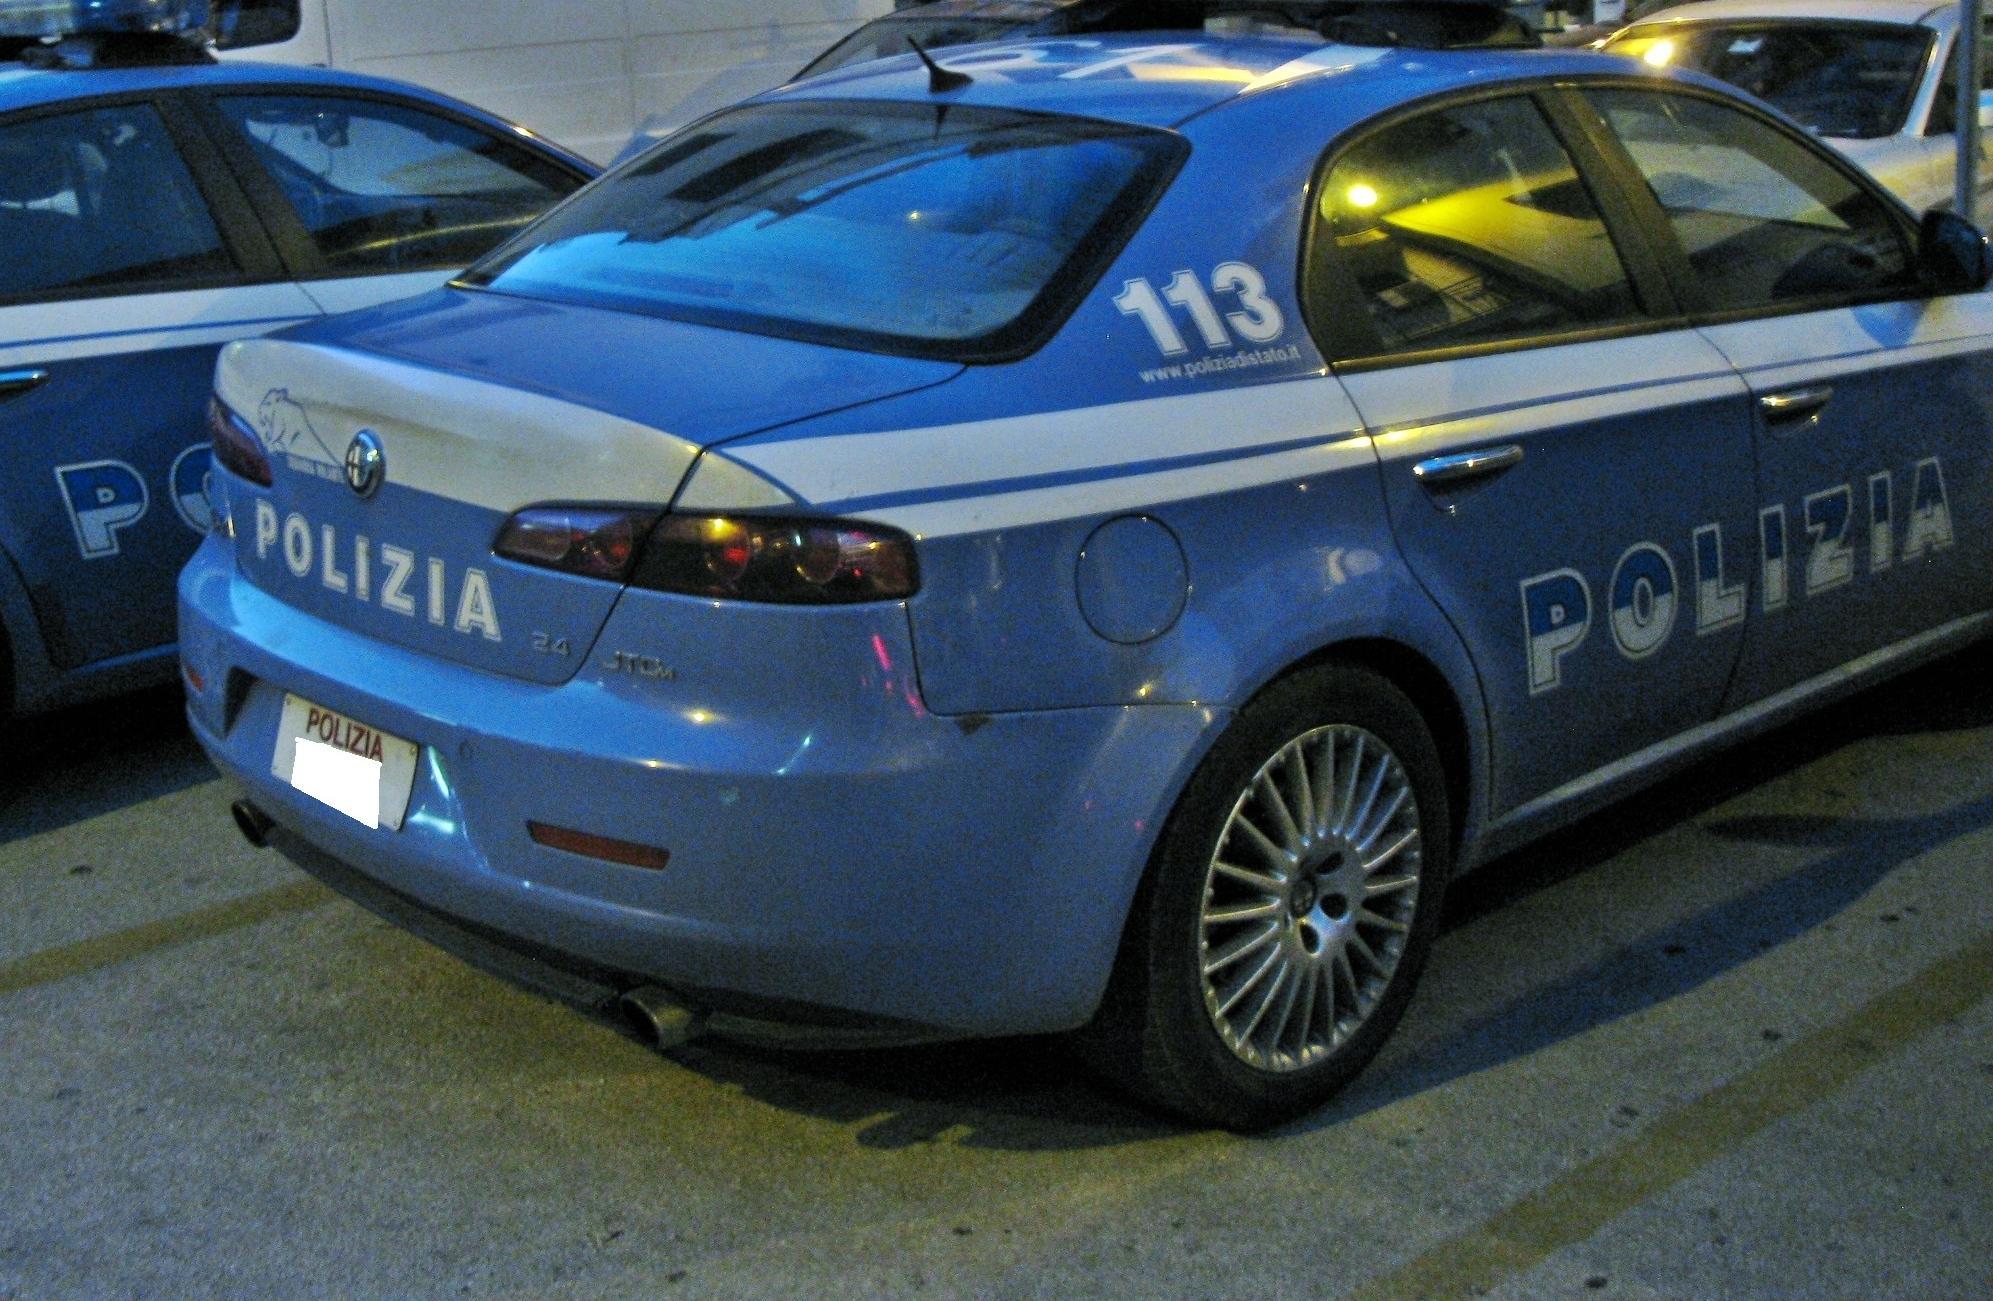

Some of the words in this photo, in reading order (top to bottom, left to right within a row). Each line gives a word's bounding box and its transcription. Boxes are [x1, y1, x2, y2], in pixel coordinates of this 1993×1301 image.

[1112, 261, 1285, 357] 113
[1138, 344, 1301, 383] www.poliziadistato.it
[256, 498, 502, 642] POLIZIA
[1519, 456, 1954, 695] POLIZIA
[306, 708, 384, 763] POLIZIA
